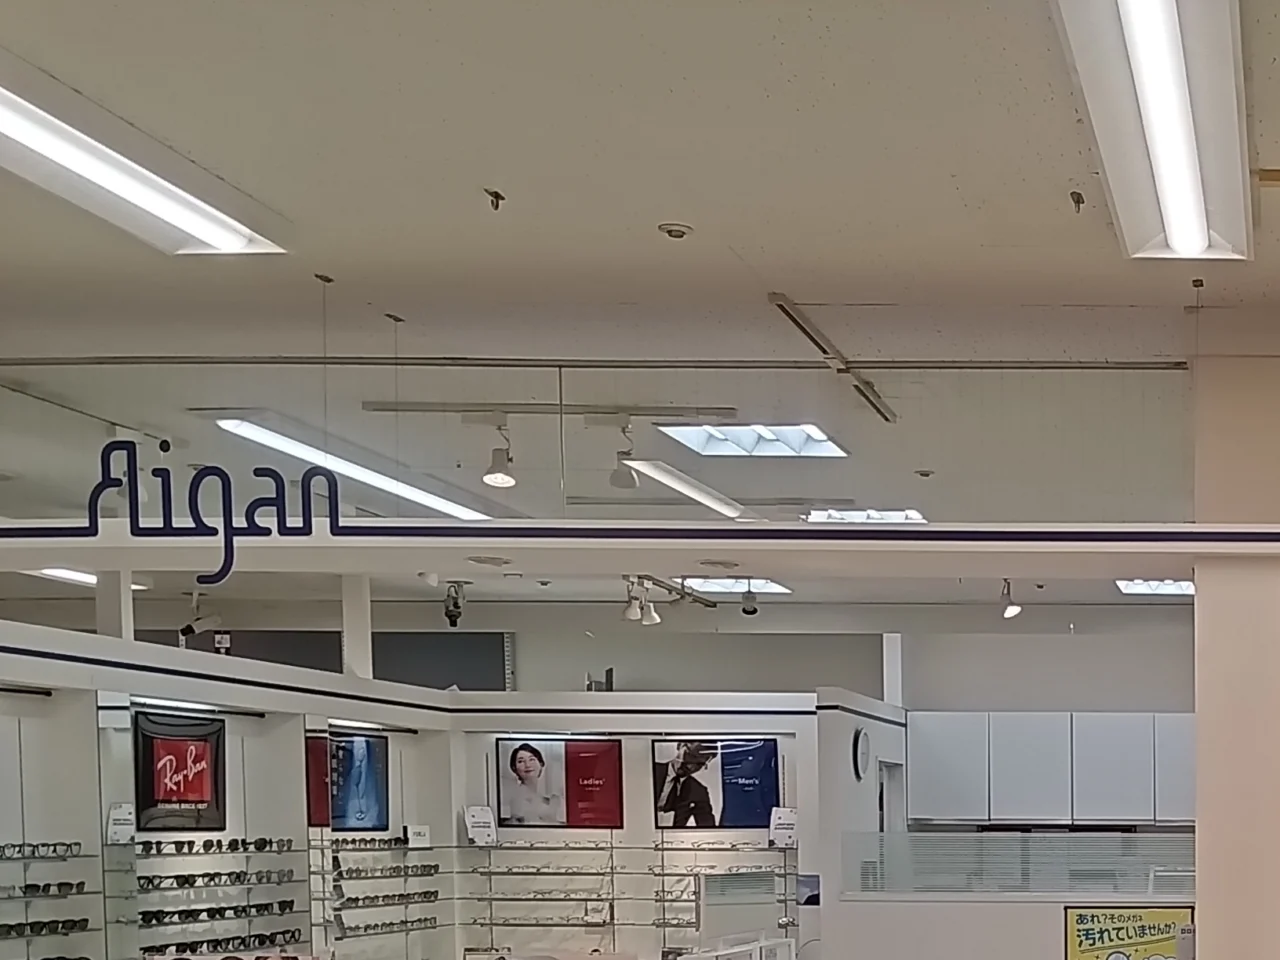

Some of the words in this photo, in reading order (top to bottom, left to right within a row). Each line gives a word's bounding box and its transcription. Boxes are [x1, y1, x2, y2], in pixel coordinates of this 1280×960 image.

[86, 440, 342, 585] Aigan
[579, 777, 606, 786] Ladies'
[1076, 922, 1176, 948] 汚れていませんか?
